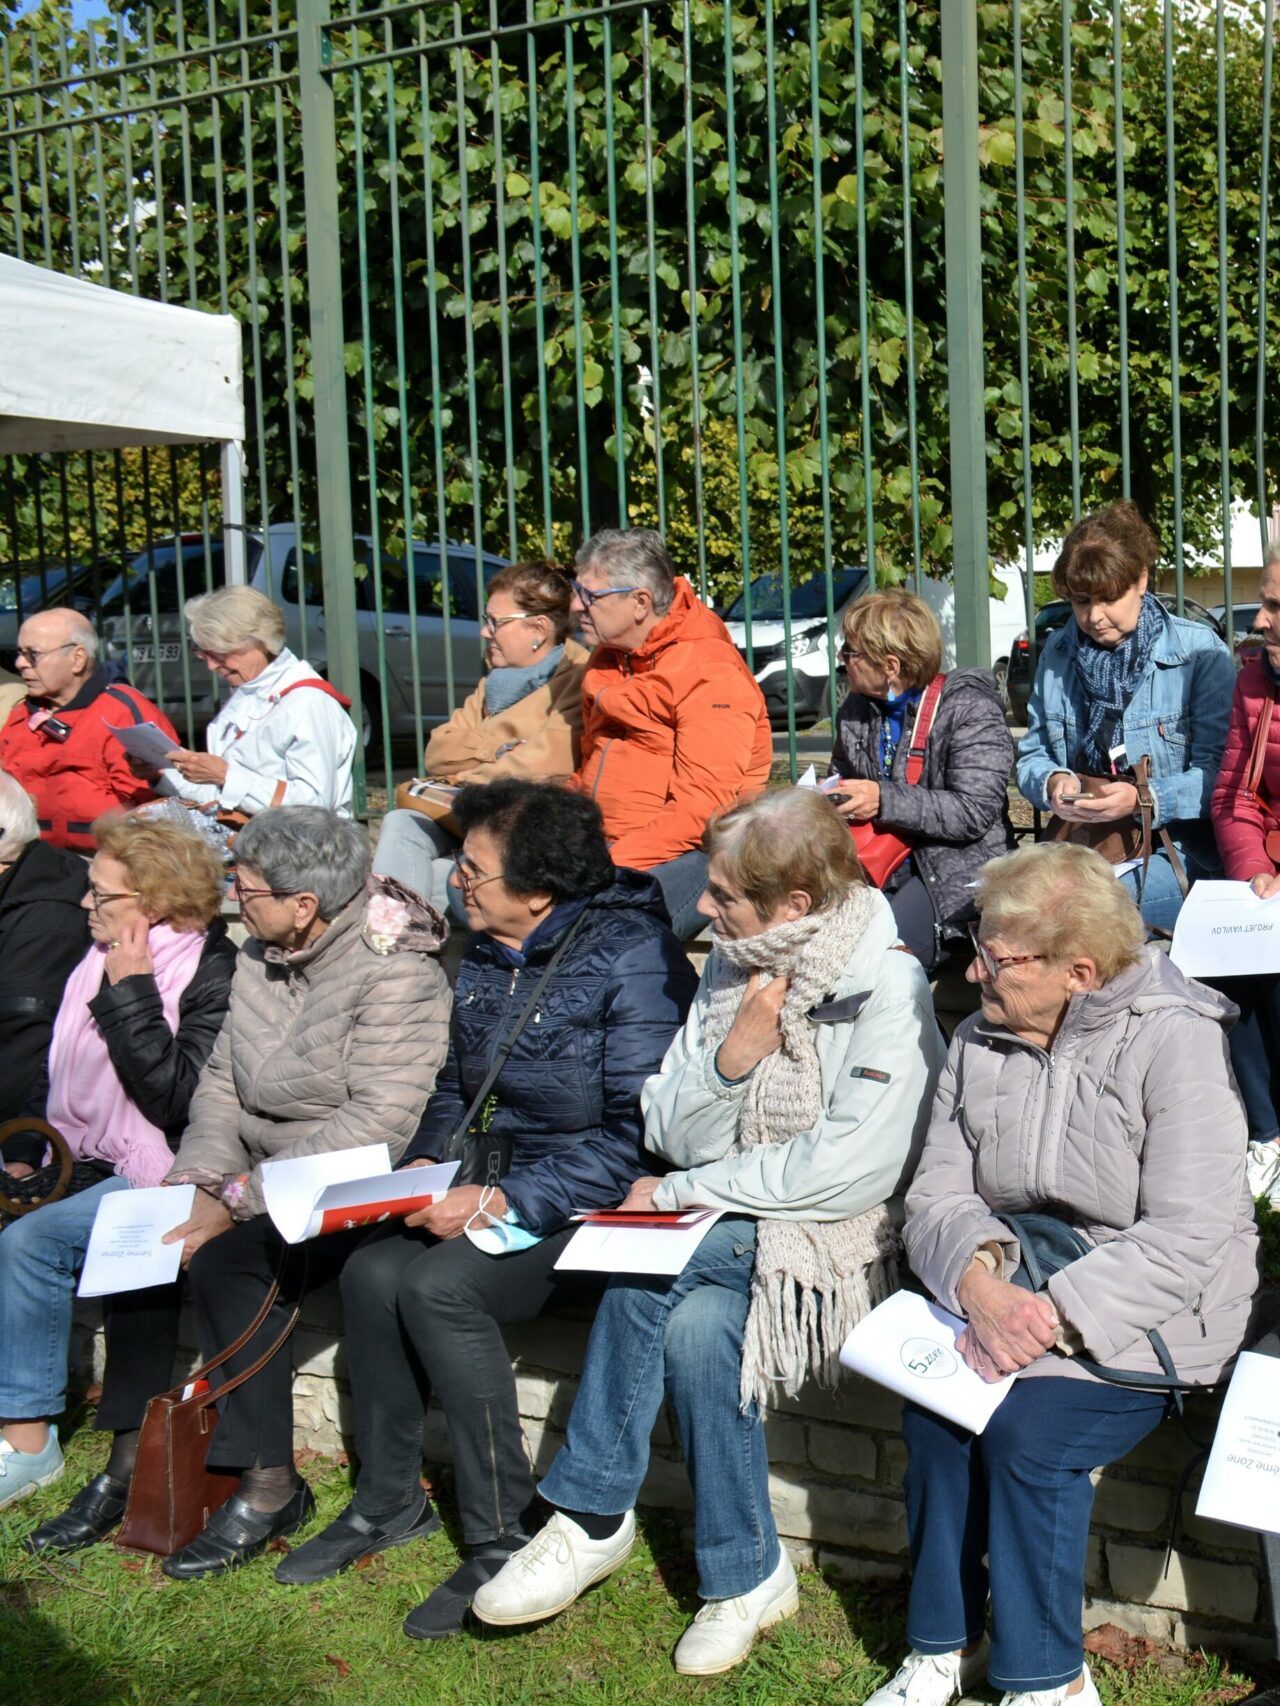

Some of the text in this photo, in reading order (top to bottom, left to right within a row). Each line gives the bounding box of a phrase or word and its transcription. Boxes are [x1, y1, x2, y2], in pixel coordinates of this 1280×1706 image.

[1211, 923, 1274, 935] PROJET VAVILOV
[907, 1358, 928, 1375] 5
[1226, 1453, 1253, 1470] Zone
